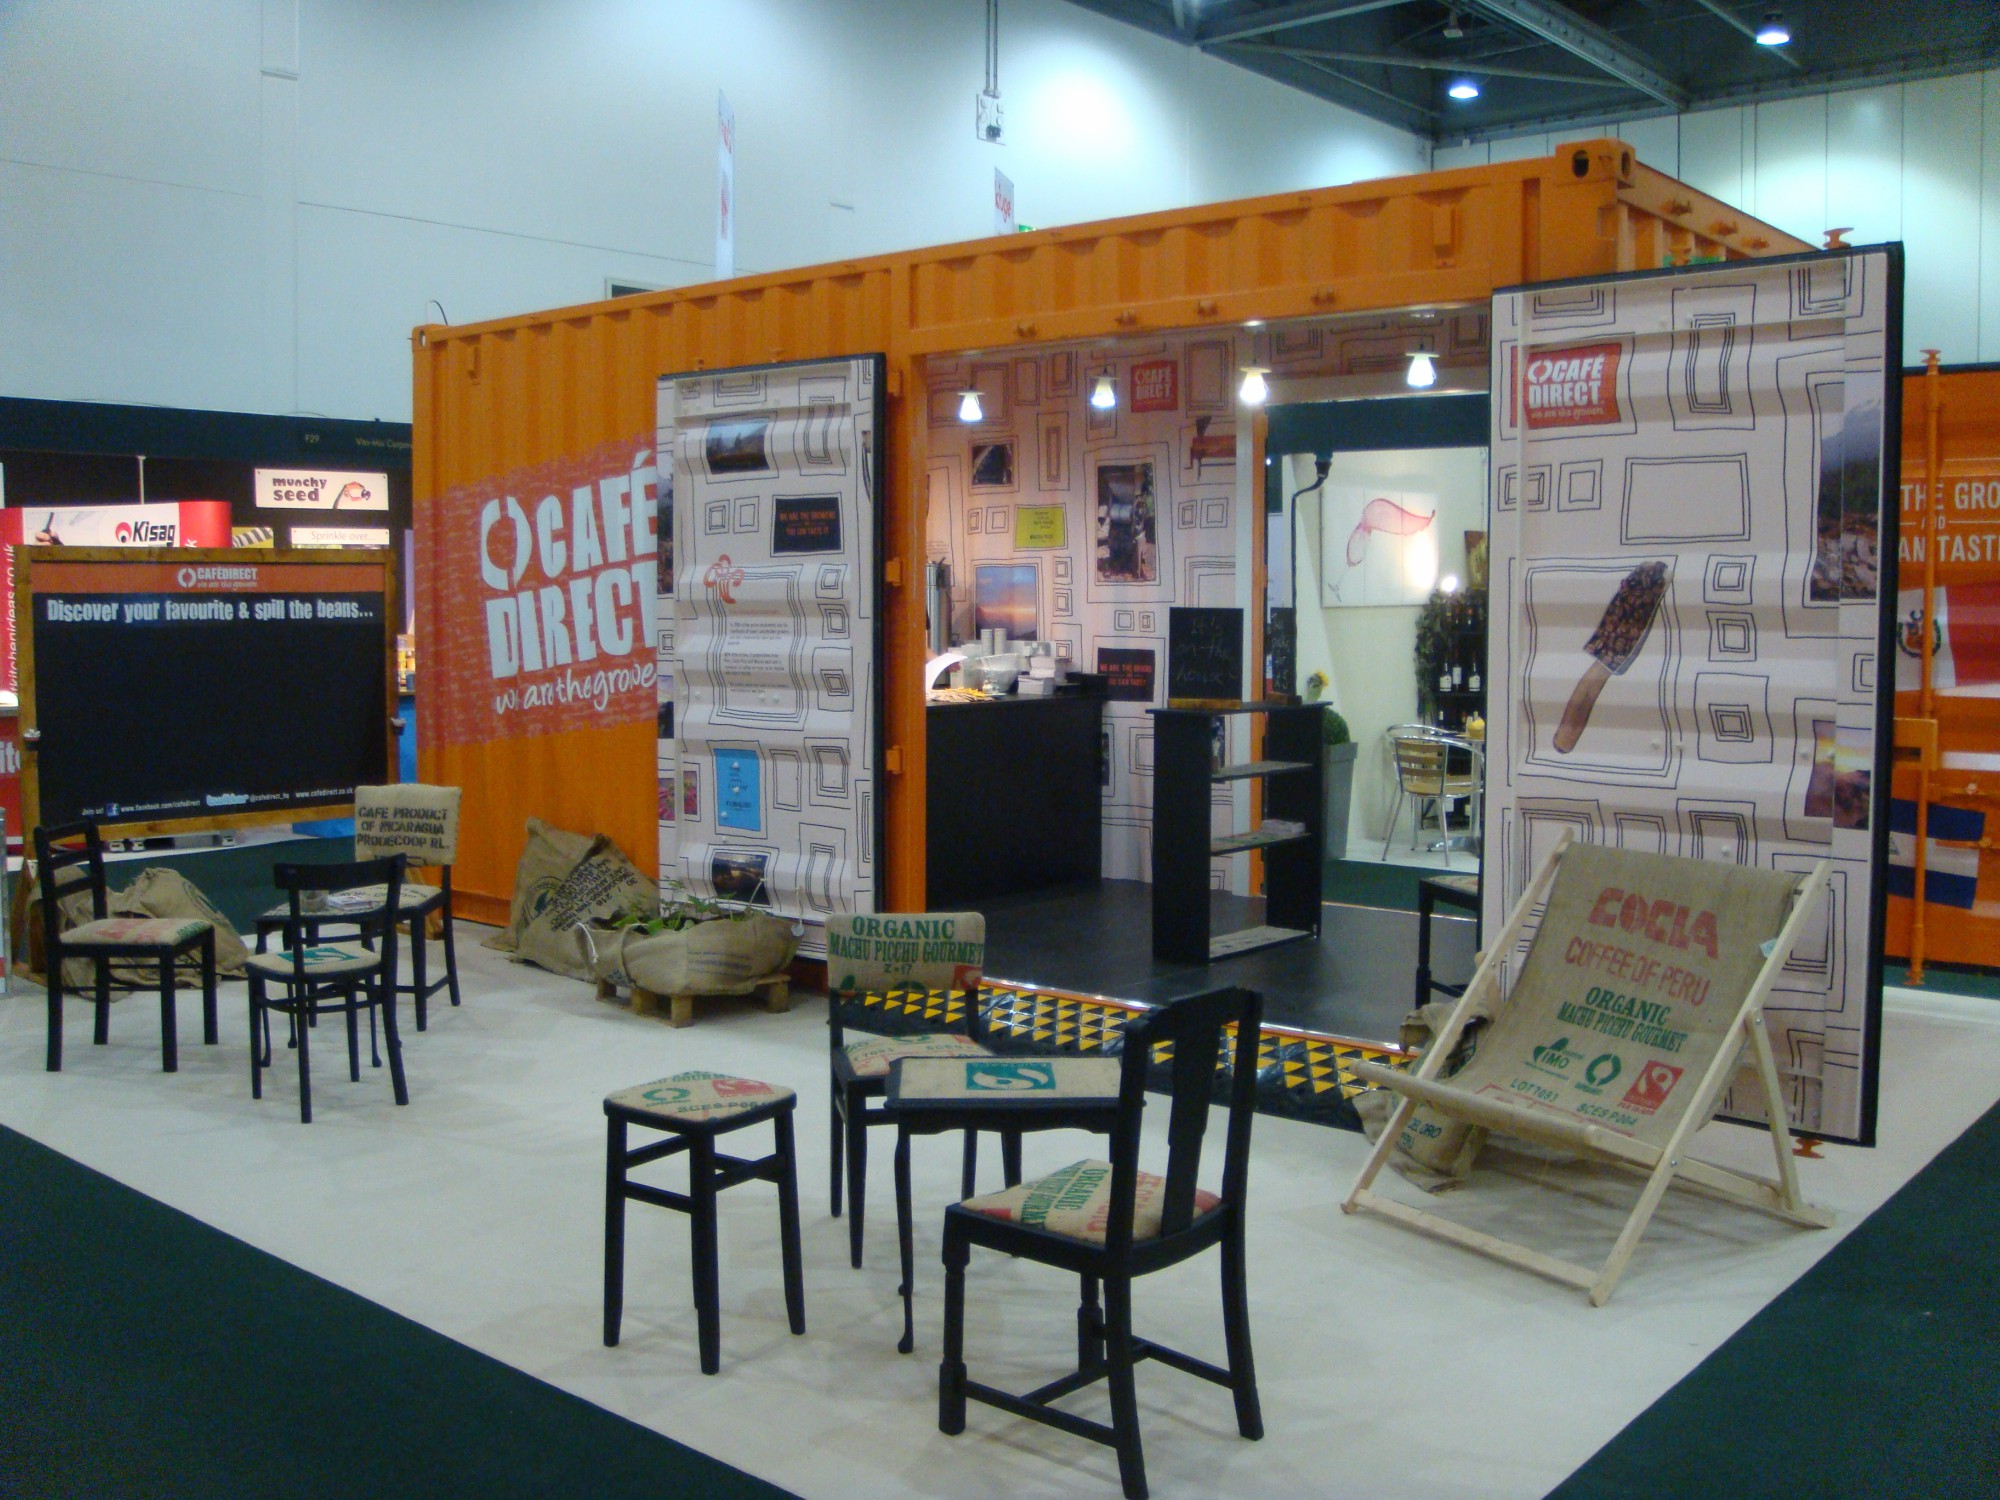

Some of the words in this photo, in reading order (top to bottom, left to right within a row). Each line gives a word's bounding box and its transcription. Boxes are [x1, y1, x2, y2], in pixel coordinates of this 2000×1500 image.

[1529, 381, 1601, 409] DIRECT
[272, 477, 327, 489] munchy
[273, 488, 320, 502] seed
[536, 449, 658, 578] CAFÉ
[133, 520, 175, 548] Kisag
[311, 530, 347, 543] Sprinkle
[48, 599, 118, 622] Discover
[124, 601, 160, 624] your
[165, 599, 234, 621] favourite
[238, 601, 250, 620] &
[254, 598, 285, 621] spill
[289, 600, 312, 620] the
[485, 560, 658, 679] DIRECT
[393, 807, 448, 821] PRODUCT
[852, 916, 956, 941] ORGANIC
[1587, 887, 1719, 961] COCLA
[829, 931, 871, 960] MACHU
[873, 939, 919, 964] PICCHU
[922, 940, 984, 965] GOURMET
[1564, 935, 1635, 979] COFFEE
[1631, 955, 1662, 987] OF
[1658, 965, 1712, 1007] PERU
[1584, 986, 1671, 1026] ORGANIC
[1557, 1001, 1597, 1029] MACHU
[1630, 1021, 1688, 1053] GOURMET
[1540, 1050, 1569, 1069] IMO
